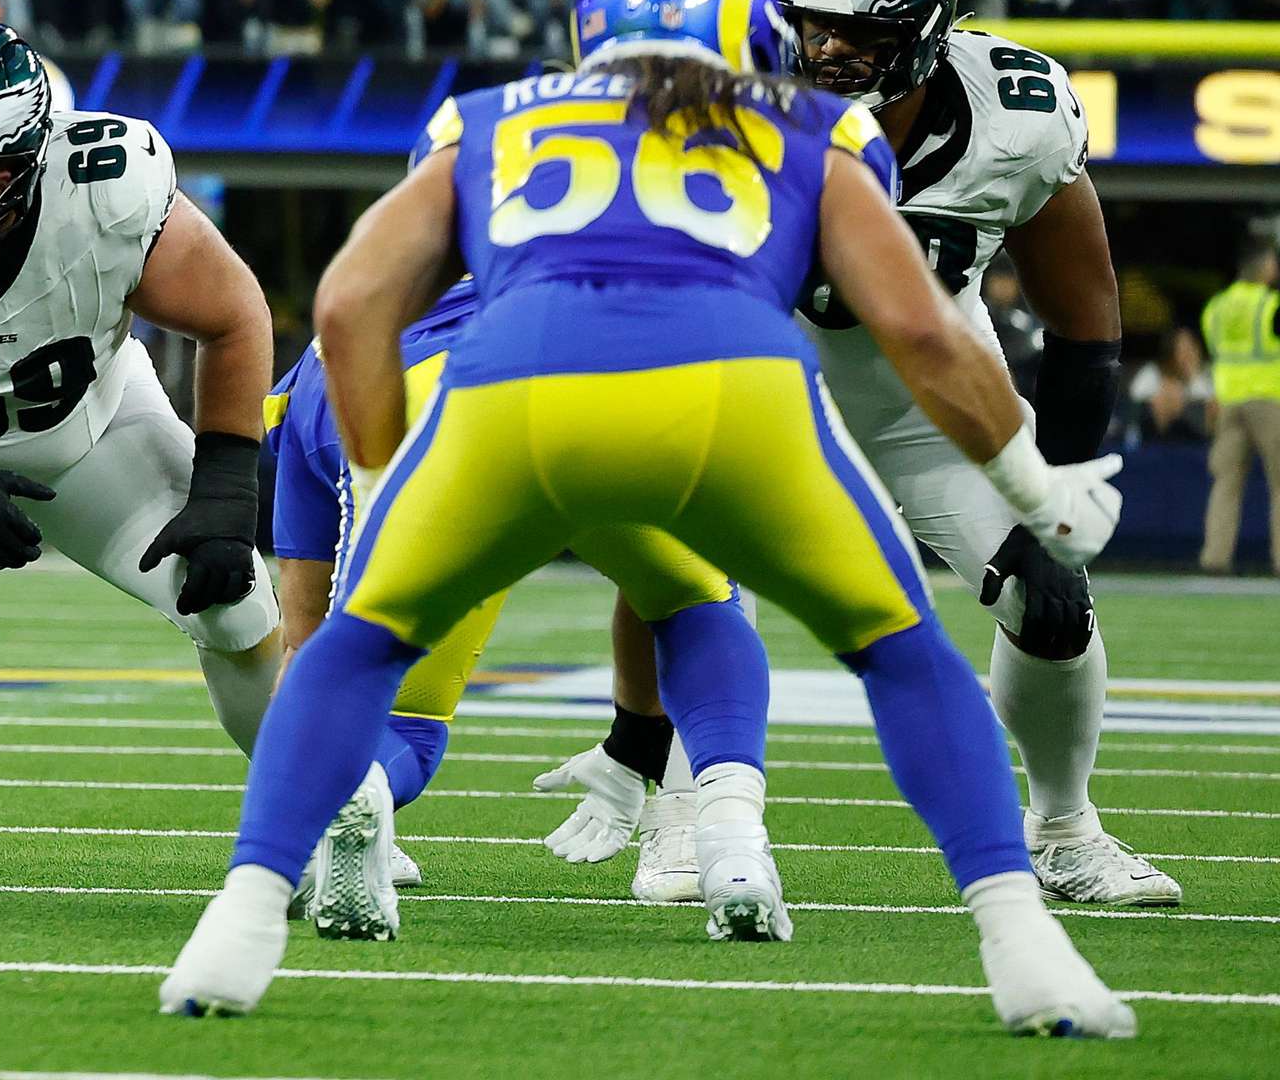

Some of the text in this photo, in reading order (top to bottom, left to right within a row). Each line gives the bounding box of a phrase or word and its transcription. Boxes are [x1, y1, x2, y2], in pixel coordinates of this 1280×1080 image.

[989, 46, 1057, 113] 68
[67, 118, 128, 184] 69
[488, 99, 785, 258] 56
